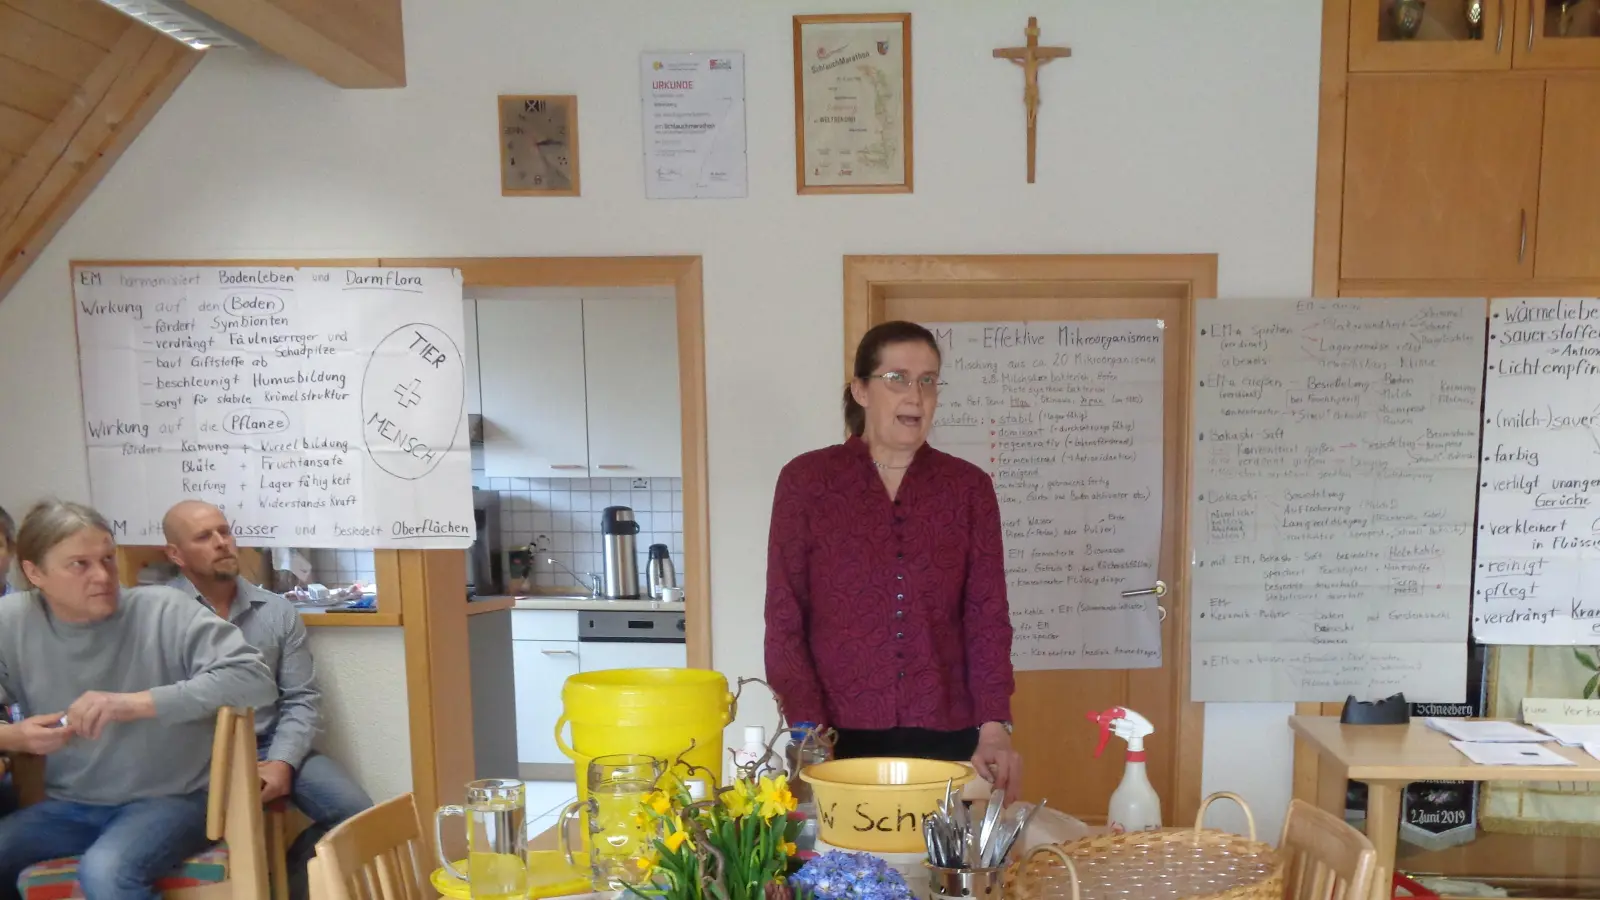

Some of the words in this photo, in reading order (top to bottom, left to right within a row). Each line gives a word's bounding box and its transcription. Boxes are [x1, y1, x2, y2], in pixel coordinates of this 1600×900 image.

[652, 80, 693, 90] URKUNDE
[80, 271, 102, 286] EM
[120, 274, 201, 287] harmonisiert
[218, 270, 294, 284] Bodenleben
[312, 273, 330, 283] und
[346, 270, 423, 285] Darmflora
[81, 301, 144, 319] Wirkung
[155, 296, 187, 313] auf
[198, 300, 220, 312] den
[231, 296, 275, 310] Boden
[210, 316, 289, 333] Symbionten
[156, 336, 215, 353] verdrängt
[328, 331, 349, 342] und
[933, 328, 953, 348] M
[983, 326, 1045, 349] Effektive
[1058, 326, 1160, 350] Mikroorganismen
[409, 331, 446, 368] TIER
[156, 356, 182, 369] baut
[191, 357, 245, 368] Giftstoffe
[252, 357, 268, 368] ab
[1053, 353, 1068, 367] 20
[156, 376, 240, 391] beschleunigt
[253, 371, 346, 389] Humusbildung
[155, 396, 182, 410] sorgt
[194, 393, 209, 404] für
[217, 394, 252, 404] stabile
[1000, 411, 1034, 424] stabil
[88, 419, 149, 438] Wirkung
[159, 421, 184, 435] auf
[200, 421, 218, 432] die
[231, 415, 285, 431] Pflanze
[367, 412, 436, 464] MENSCH
[1494, 443, 1539, 466] farbig
[182, 459, 216, 473] Blüte
[182, 480, 227, 494] Reifung
[1493, 474, 1540, 494] vertilgt
[1535, 492, 1592, 507] Gerüche
[113, 520, 127, 536] M
[295, 524, 316, 536] und
[334, 523, 382, 537] besiedelt
[392, 519, 469, 536] Oberflächen
[1490, 519, 1567, 535] verkleinert
[1532, 538, 1544, 550] in
[1488, 557, 1550, 576] reinigt
[1485, 581, 1540, 602] pflegt
[1484, 607, 1562, 624] verdrängt
[1416, 702, 1473, 717] Schneeberg
[1440, 809, 1466, 825] 2019
